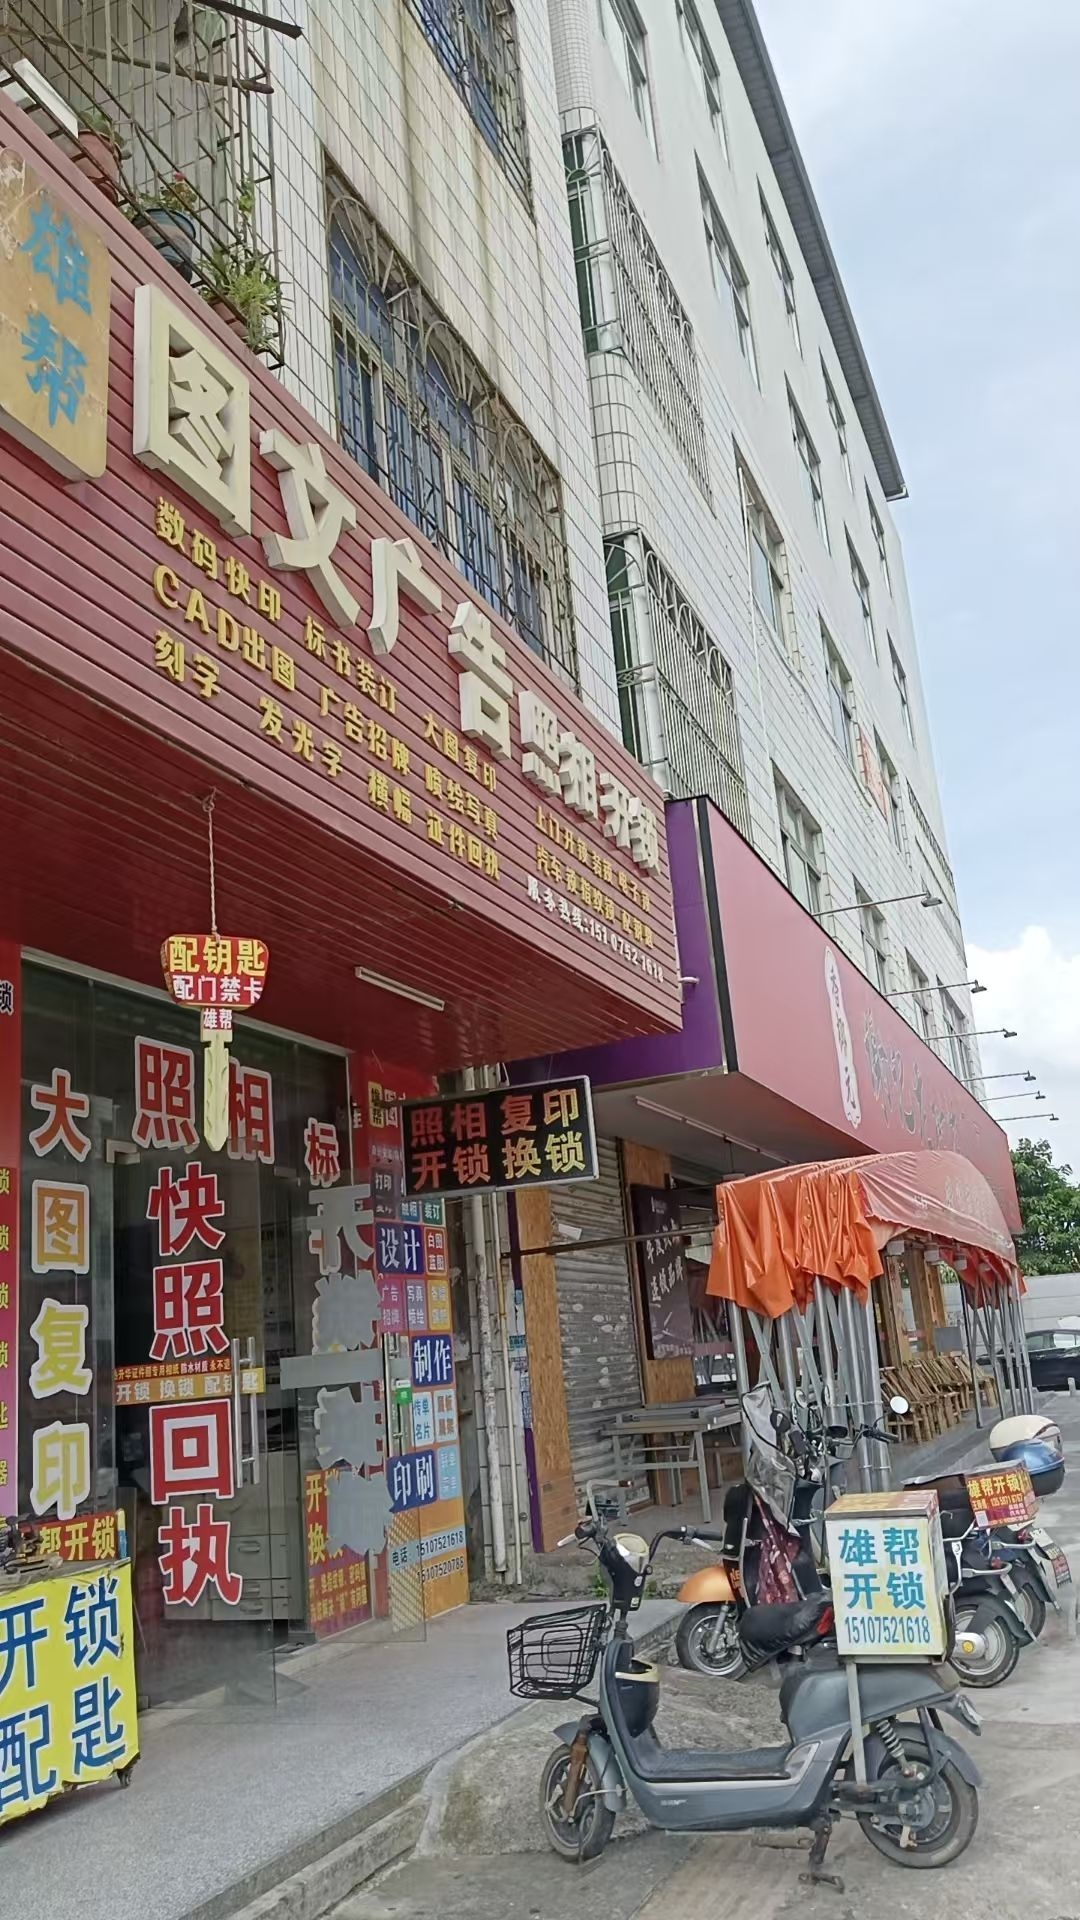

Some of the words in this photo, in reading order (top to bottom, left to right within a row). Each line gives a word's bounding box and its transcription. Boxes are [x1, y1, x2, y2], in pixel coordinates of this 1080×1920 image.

[22, 200, 91, 428] 雄帮
[133, 283, 513, 760] 图文广告
[519, 690, 662, 878] 照相开锁
[156, 496, 281, 620] 数码快印
[304, 615, 397, 714] 标书装订
[423, 712, 496, 794] 大图复印
[154, 565, 295, 692] CAD出图
[320, 687, 411, 776] 广告招牌
[425, 764, 498, 841] 喷绘写真
[155, 629, 221, 699] 刻字
[259, 695, 343, 778] 发光字
[368, 769, 413, 825] 横幅
[427, 811, 501, 881] 证件回执
[169, 936, 266, 977] 配钥匙
[172, 974, 263, 1004] 配门禁卡
[202, 1008, 233, 1030] 雄帮
[411, 1102, 487, 1149] 照相
[501, 1088, 580, 1136] 复印
[412, 1144, 491, 1191] 开锁
[502, 1130, 586, 1180] 换锁
[380, 1228, 420, 1271] 设计
[29, 1067, 92, 1521] 大图复印
[381, 1284, 399, 1302] 广告
[413, 1339, 452, 1383] 制作
[116, 1382, 151, 1403] 开锁
[159, 1377, 195, 1400] 换锁
[146, 1161, 243, 1607] 快照回执
[393, 1454, 434, 1506] 印刷
[967, 1474, 1021, 1499] 雄帮开锁
[416, 1531, 464, 1557] 15107521618
[838, 1527, 920, 1567] 雄帮
[843, 1571, 926, 1610] 开锁
[0, 1577, 119, 1695] 开锁
[845, 1616, 931, 1645] 15107521618
